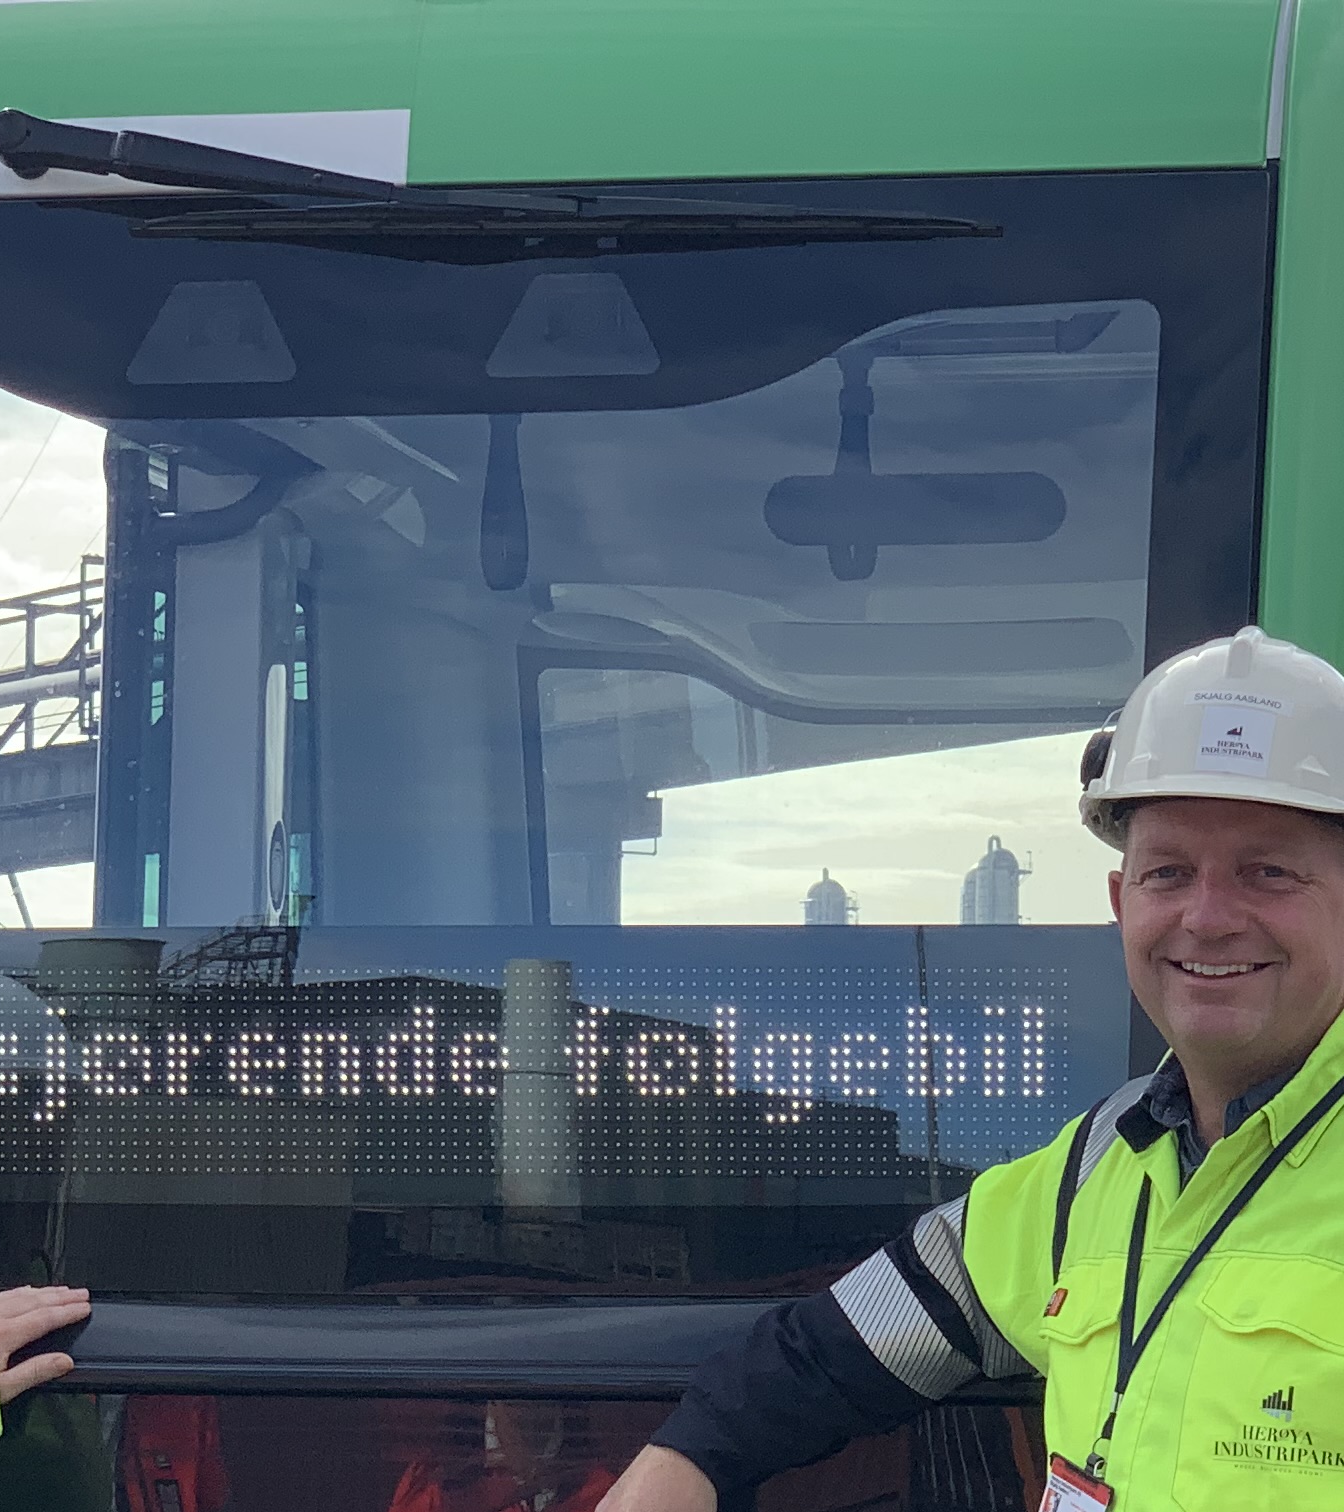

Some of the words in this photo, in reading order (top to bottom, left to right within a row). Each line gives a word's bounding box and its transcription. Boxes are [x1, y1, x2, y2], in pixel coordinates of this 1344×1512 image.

[1194, 692, 1233, 701] SKJALG
[1234, 694, 1282, 709] AASLAND
[1201, 746, 1264, 760] INDUSTRIPARK
[562, 1005, 1046, 1123] følgebil
[1243, 1424, 1313, 1446] HERØYA
